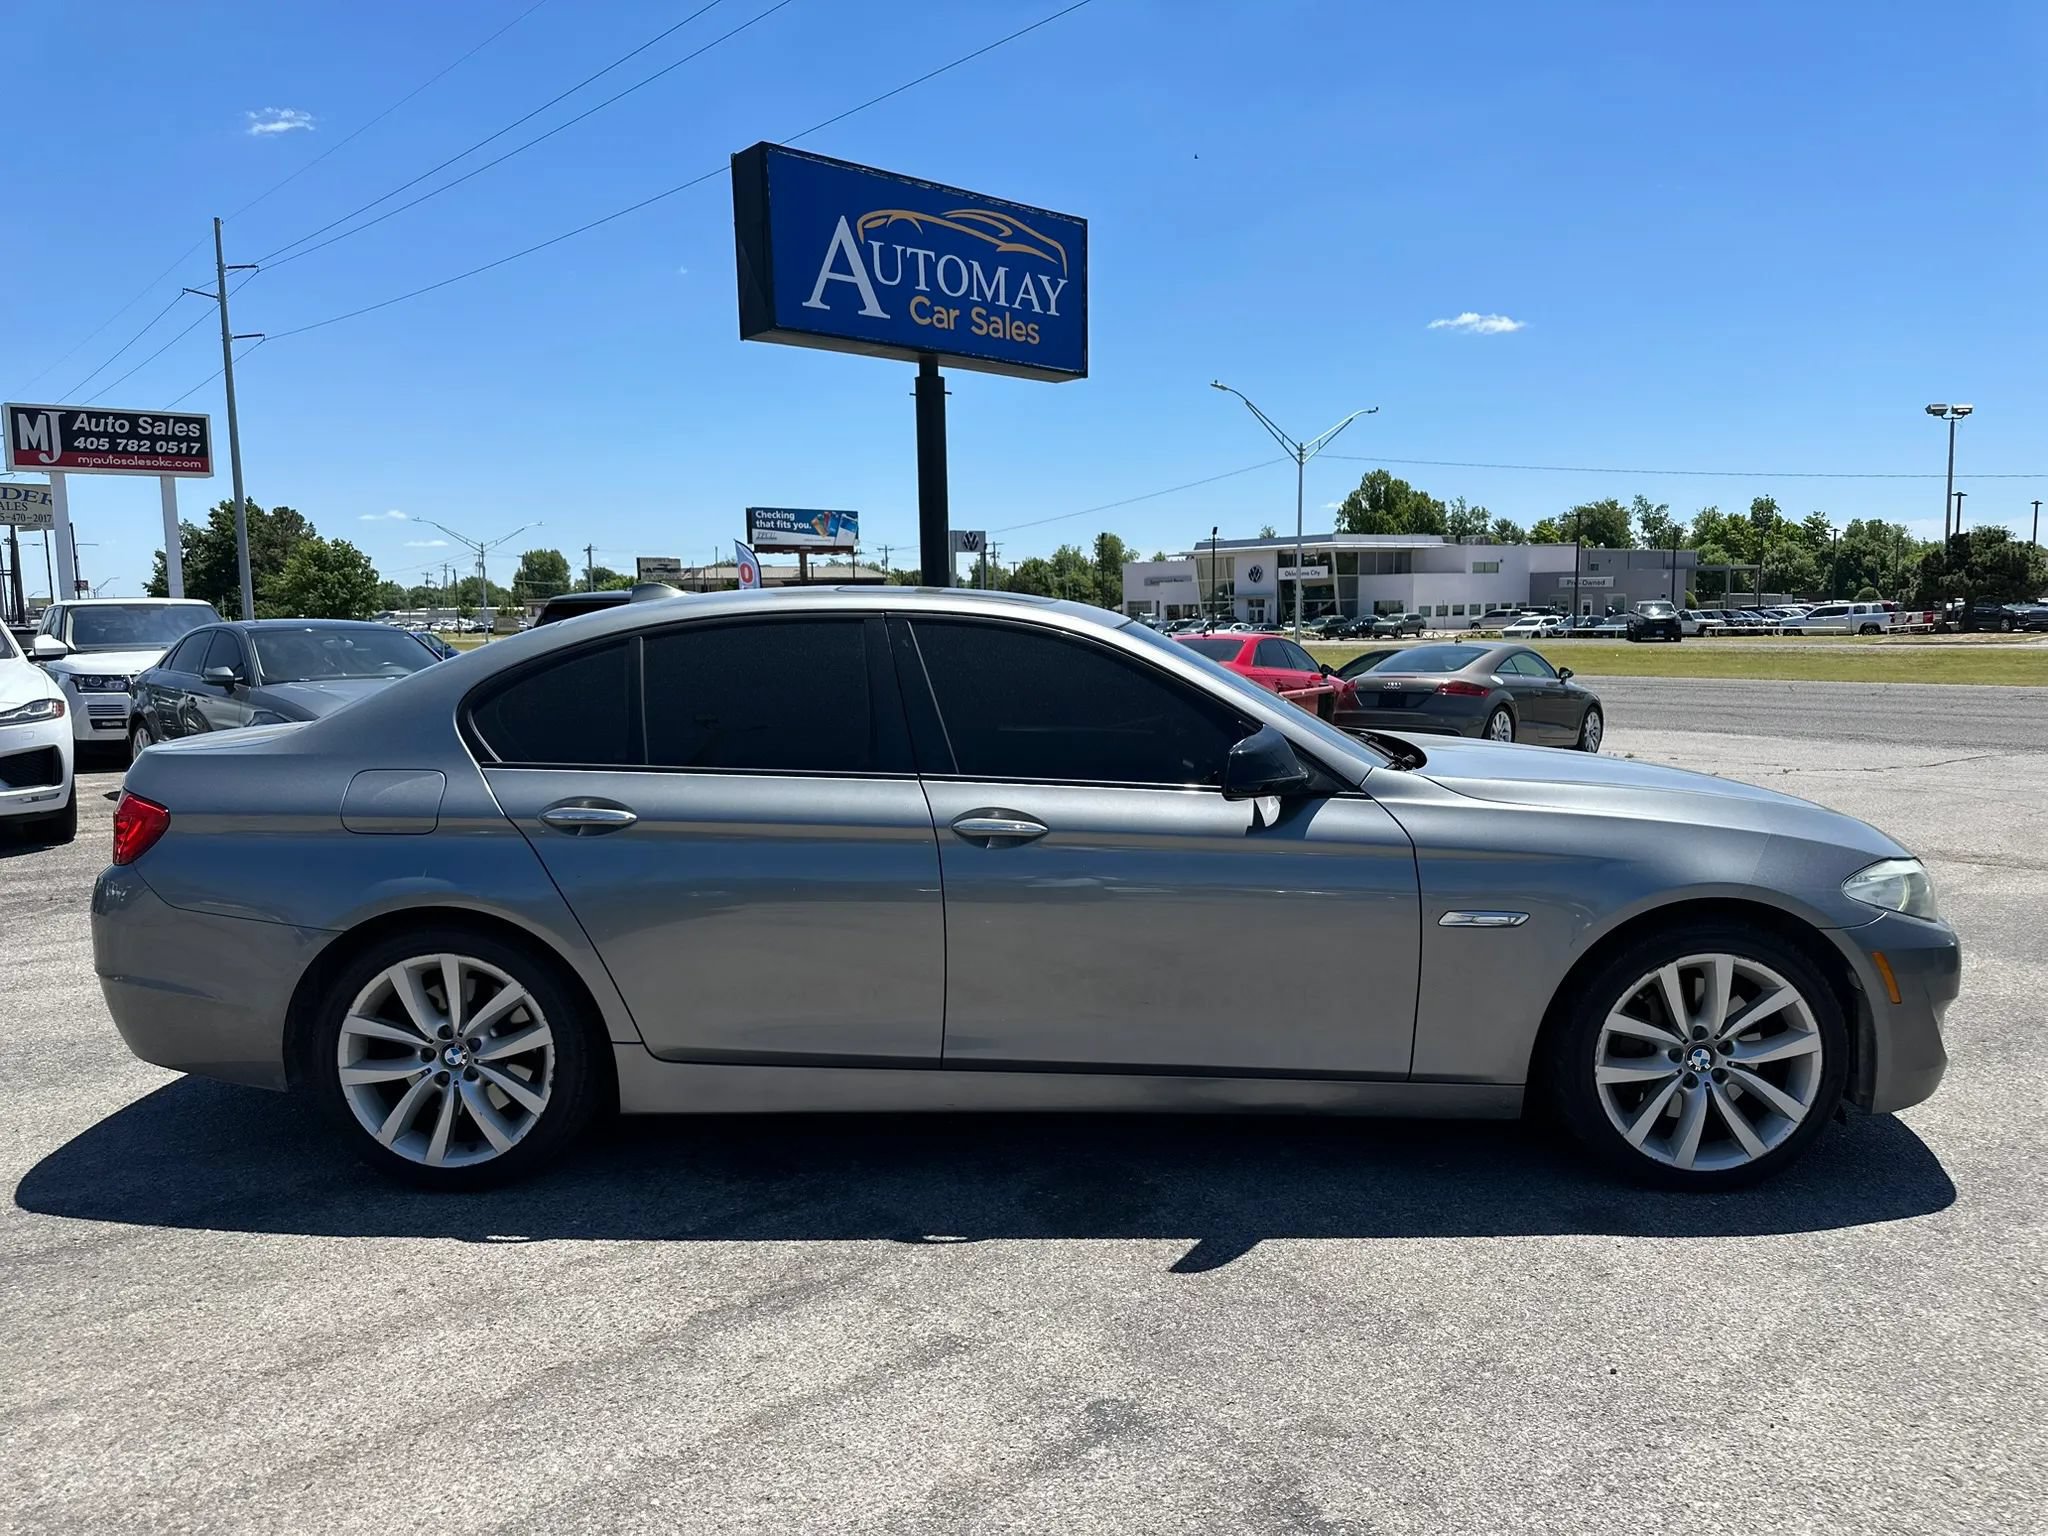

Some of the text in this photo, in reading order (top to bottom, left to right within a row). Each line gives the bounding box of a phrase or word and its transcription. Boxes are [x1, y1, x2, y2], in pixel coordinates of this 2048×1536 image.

[909, 295, 1040, 345] Car Sales
[72, 413, 201, 437] Auto Sales
[18, 411, 66, 464] MJ
[73, 437, 201, 455] 405 782 0517
[77, 454, 201, 469] mjautosalesokc.com
[755, 510, 795, 521] Checking
[756, 519, 812, 531] that fits you.
